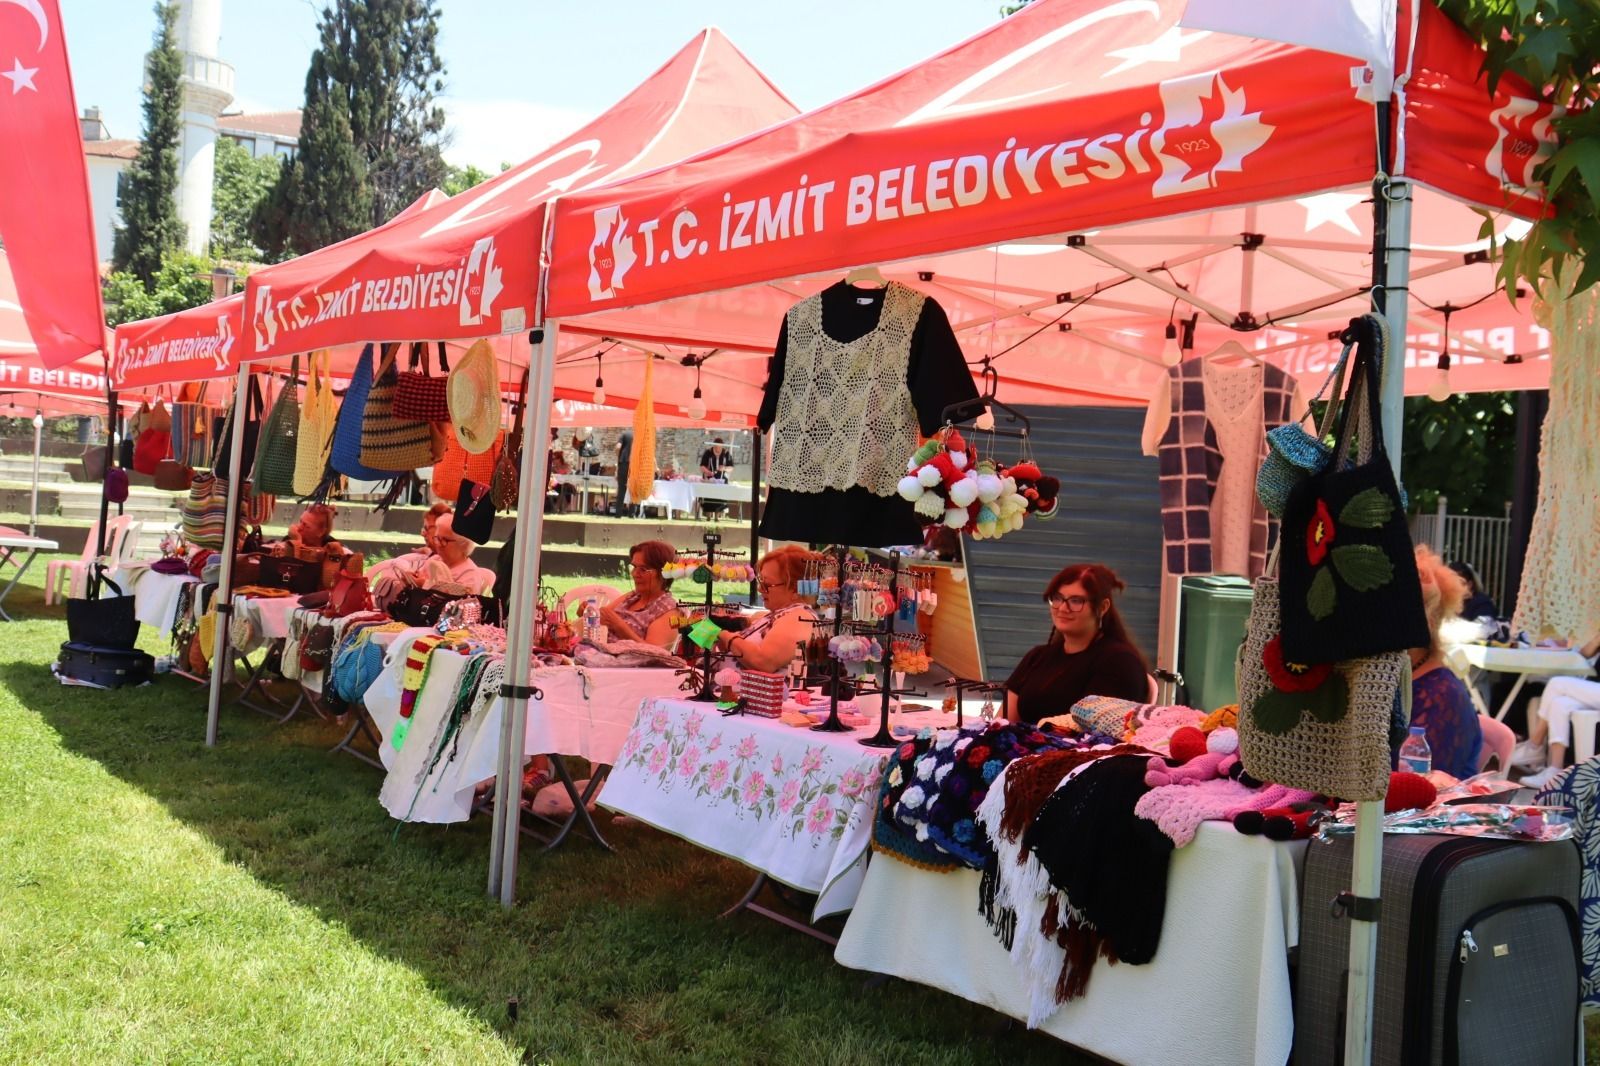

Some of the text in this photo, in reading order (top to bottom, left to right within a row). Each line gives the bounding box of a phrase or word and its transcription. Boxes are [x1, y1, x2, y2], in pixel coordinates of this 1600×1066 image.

[1175, 138, 1210, 153] 1923
[638, 112, 1152, 267] T.C. İZMİT BELEDİYESİ
[277, 258, 466, 331] T.C. İZMİT BELEDİYESİ
[143, 336, 169, 367] İZMİT
[168, 328, 219, 362] BELEDİYESİ
[28, 367, 113, 392] BELEDİ
